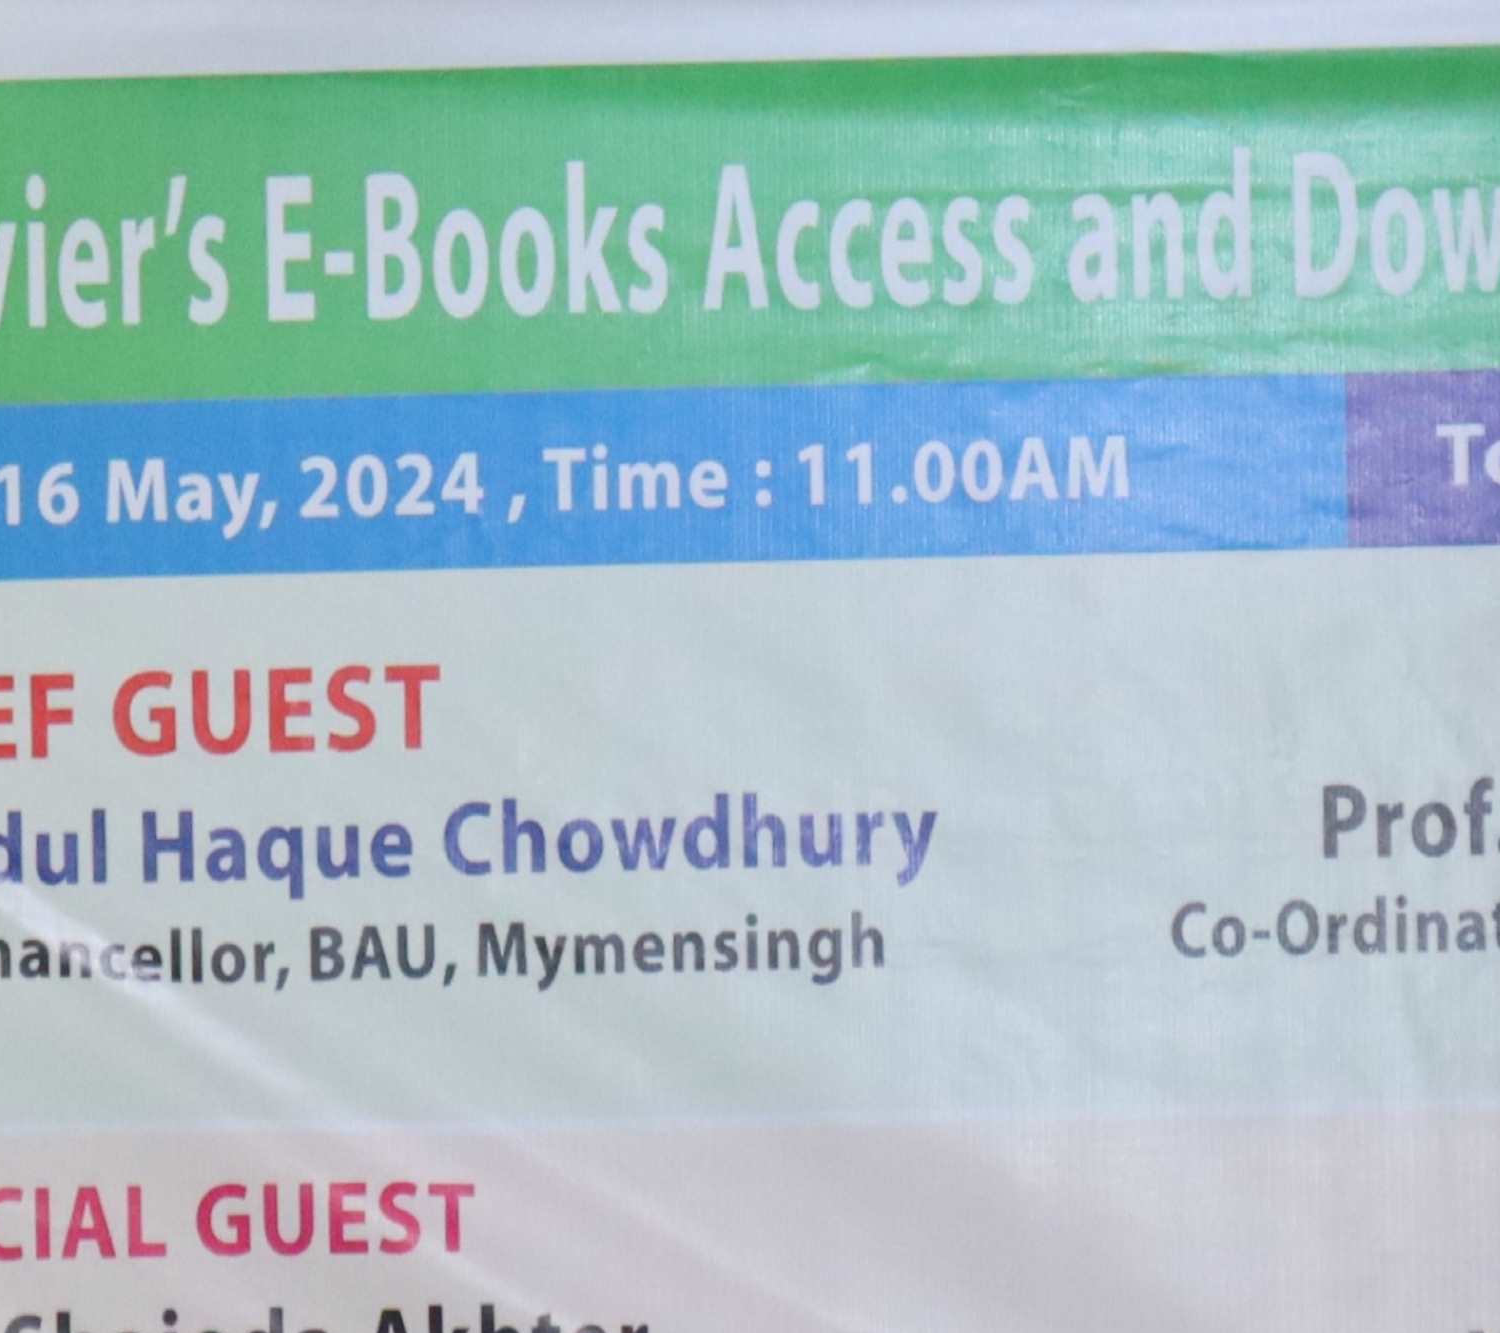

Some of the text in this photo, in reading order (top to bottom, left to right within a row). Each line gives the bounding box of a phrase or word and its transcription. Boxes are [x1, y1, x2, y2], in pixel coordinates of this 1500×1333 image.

[265, 160, 669, 321] E-Books
[702, 164, 1034, 310] Access
[1067, 145, 1252, 303] and
[107, 458, 277, 539] May,
[300, 453, 484, 518] 2024
[543, 444, 727, 511] Time
[798, 436, 1128, 505] 11.00AM
[113, 665, 440, 756] GUEST
[142, 810, 412, 900] Haque
[444, 793, 937, 885] Chowdhury
[310, 925, 456, 986] BAU,
[478, 912, 884, 991] Mymensingh
[196, 1182, 474, 1256] GUEST
